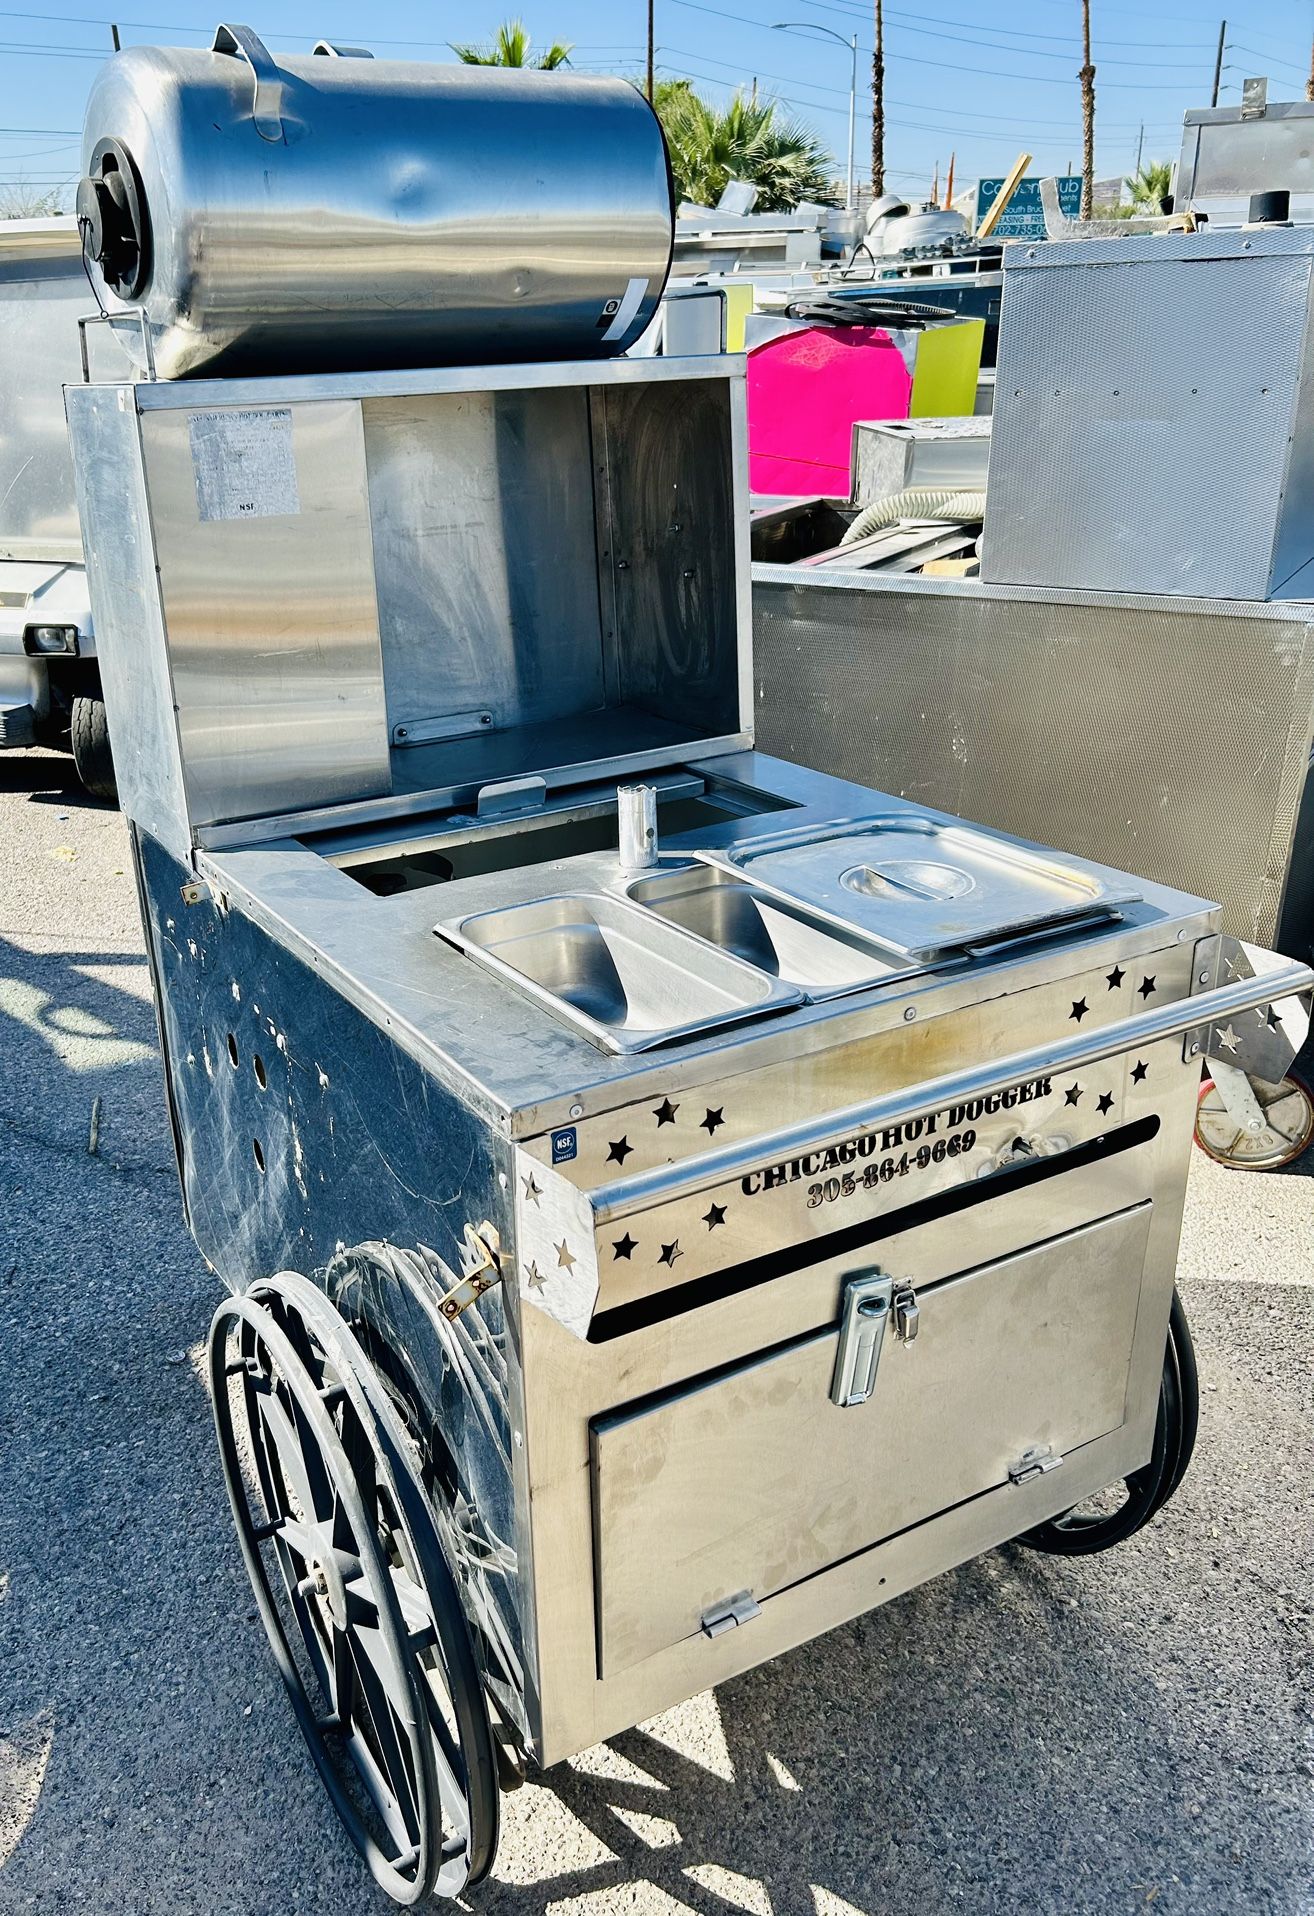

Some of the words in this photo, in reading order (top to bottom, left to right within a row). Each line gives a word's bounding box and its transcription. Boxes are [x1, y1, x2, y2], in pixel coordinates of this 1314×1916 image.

[1004, 205, 1025, 214] South
[1027, 204, 1043, 214] Bruc
[999, 215, 1025, 224] EASING
[1031, 214, 1043, 223] FRE
[741, 1134, 877, 1196] CHICAGO
[879, 1113, 942, 1152] HOT
[946, 1076, 1053, 1129] DOGGER
[557, 1136, 571, 1149] NSF
